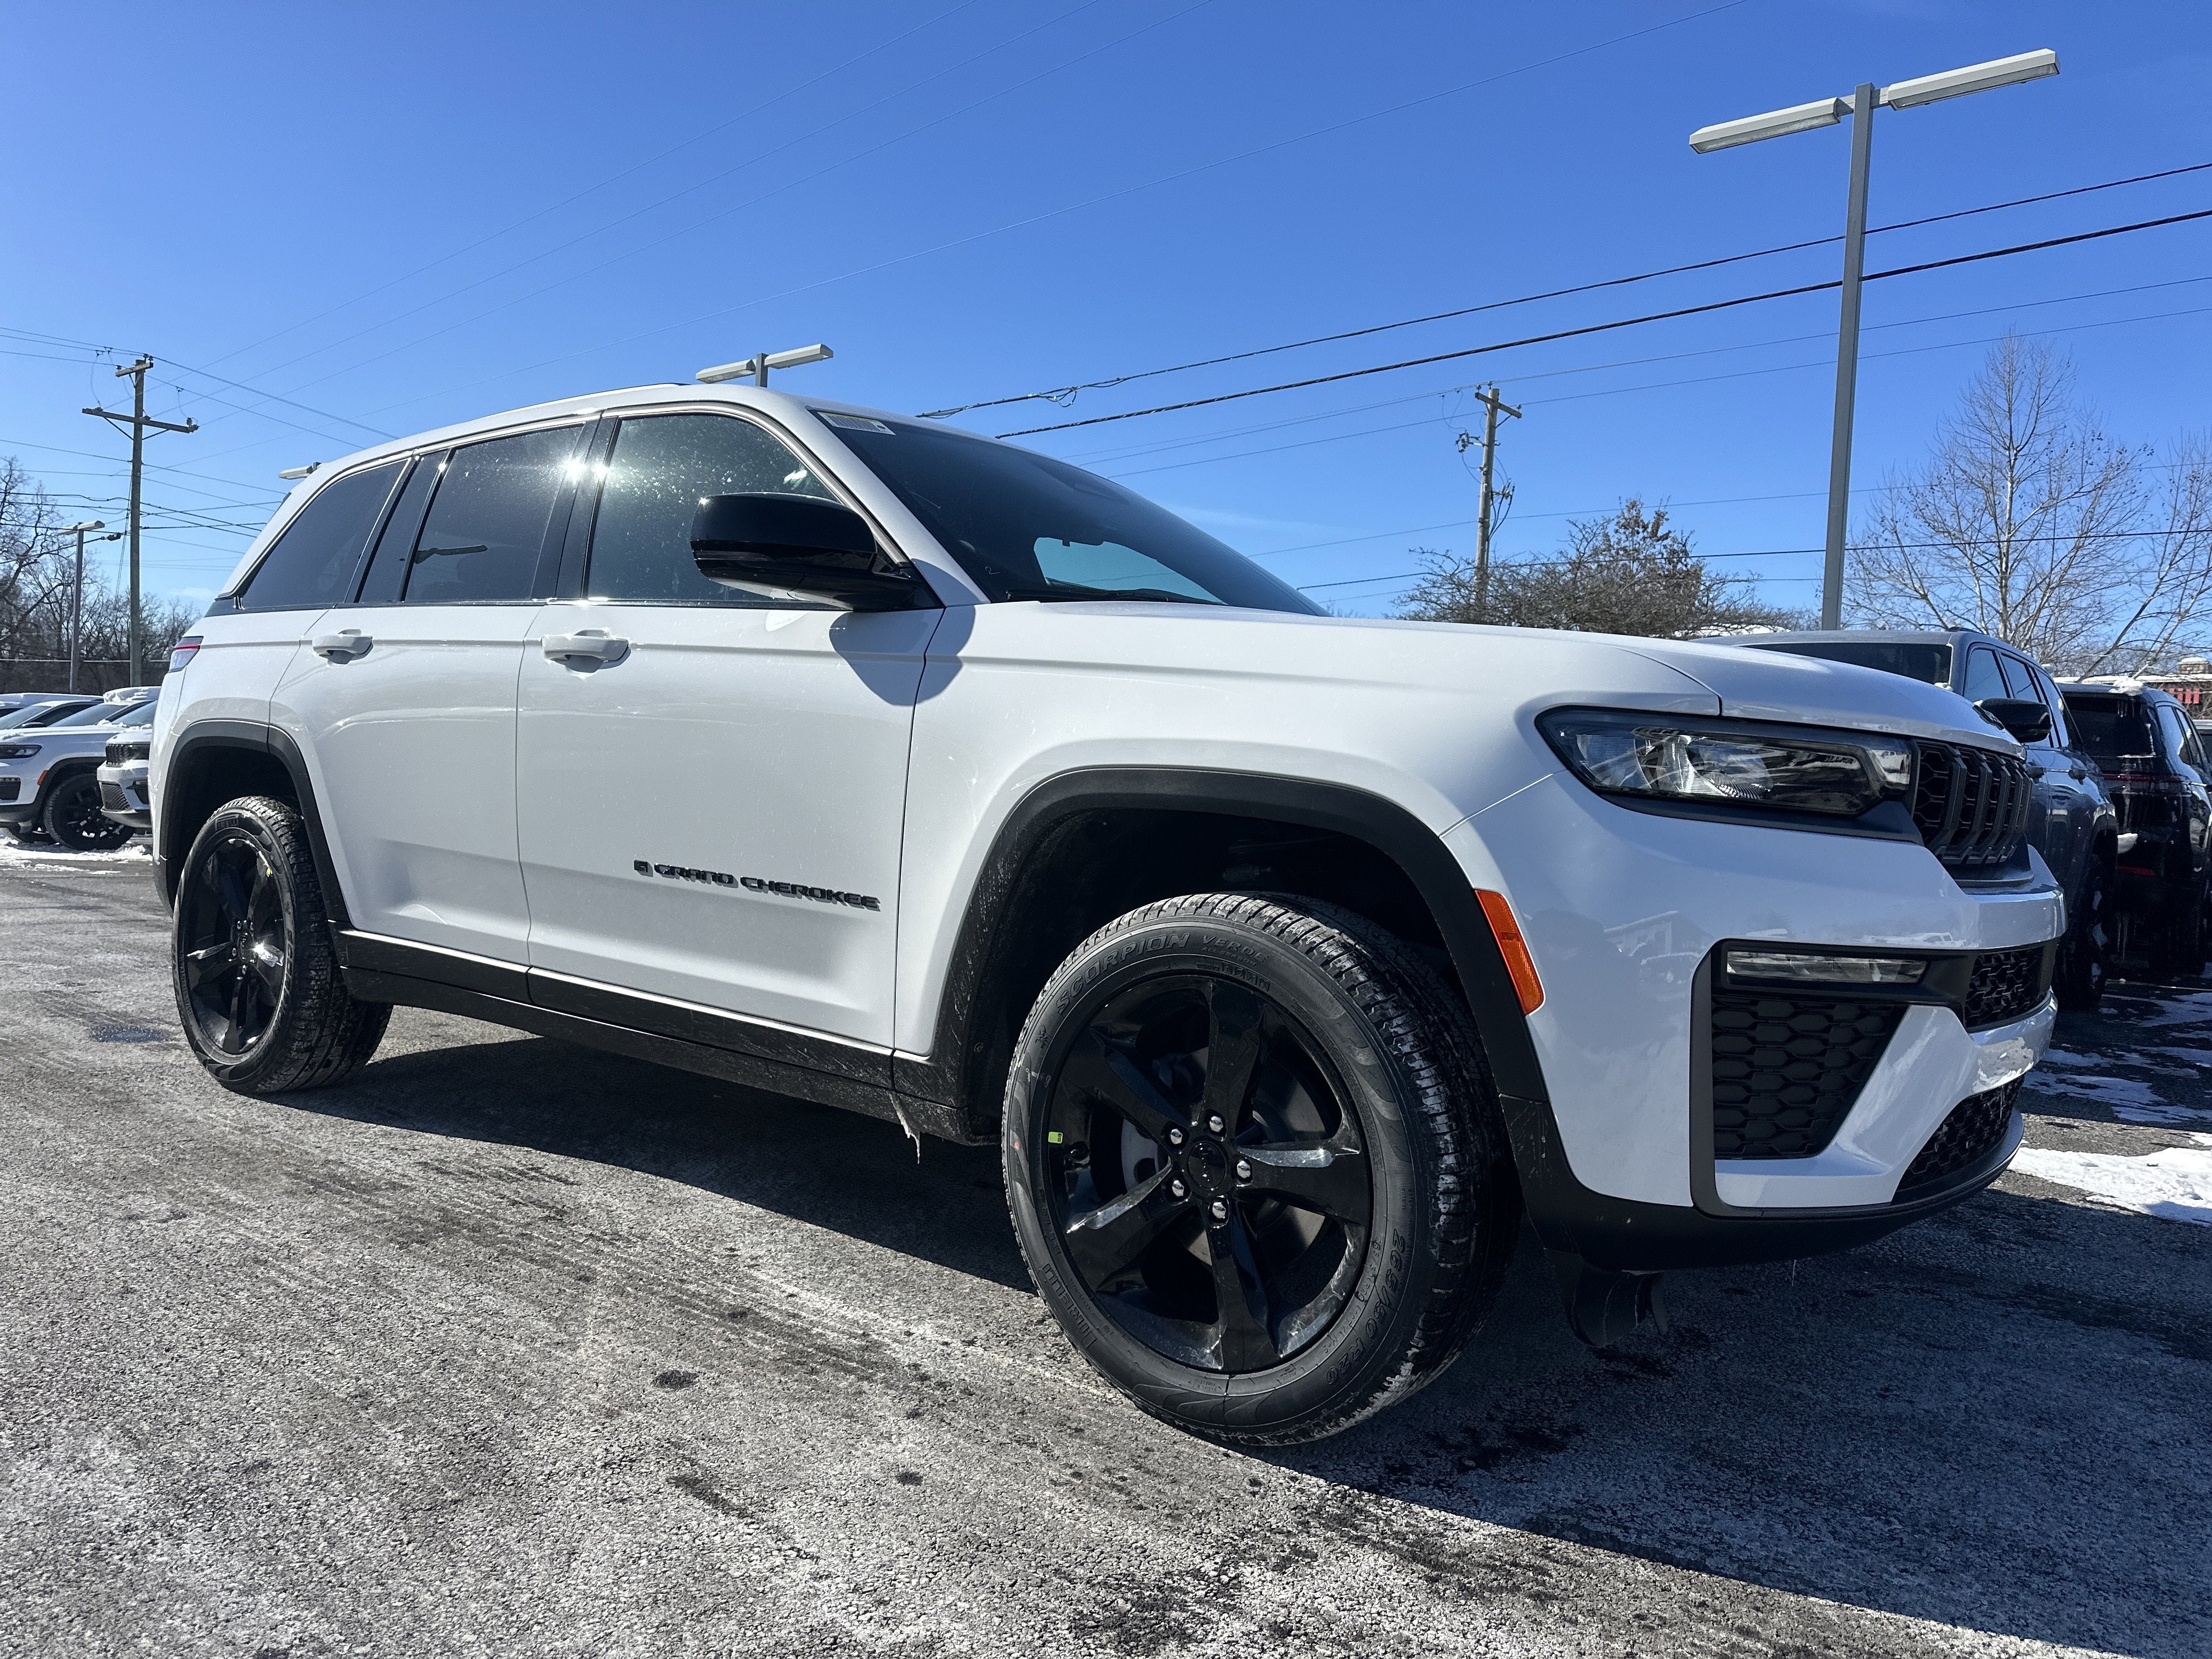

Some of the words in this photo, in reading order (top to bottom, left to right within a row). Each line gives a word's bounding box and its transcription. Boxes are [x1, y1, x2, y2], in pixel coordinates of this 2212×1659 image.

[653, 863, 735, 884] GRAND
[740, 876, 881, 909] CHEROKEE
[1056, 933, 1190, 1014] SCORPION
[1201, 934, 1268, 963] VERDE
[1038, 1263, 1097, 1349] PIRELLI
[1365, 1229, 1406, 1338] 265/50
[1326, 1338, 1363, 1384] R20
